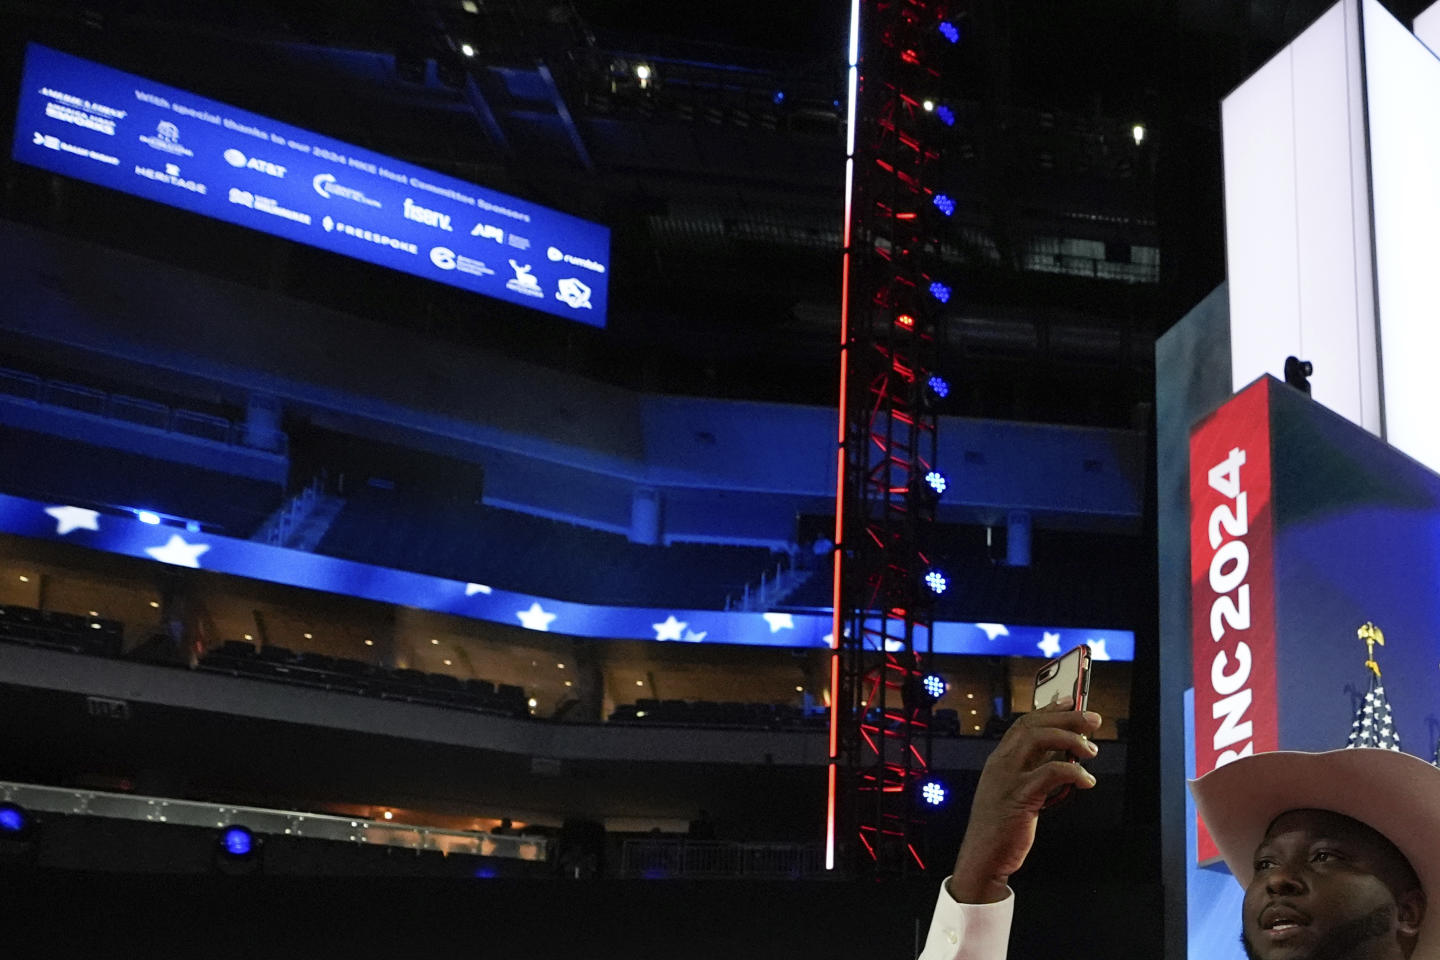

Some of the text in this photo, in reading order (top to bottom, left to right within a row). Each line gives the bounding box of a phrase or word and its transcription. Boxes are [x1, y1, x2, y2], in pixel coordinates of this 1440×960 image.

[133, 90, 171, 108] With
[170, 101, 221, 124] special
[222, 117, 269, 139] thanks
[269, 132, 286, 144] to
[286, 138, 311, 152] our
[312, 146, 346, 163] 2024
[377, 167, 408, 183] Host
[408, 177, 476, 204] Committee
[476, 198, 531, 221] Sponsors
[246, 157, 288, 178] AT&T
[134, 166, 207, 194] HERITAGE
[335, 222, 418, 255] FREESPOKE
[563, 255, 606, 273] rumble
[1207, 446, 1251, 643] 2024
